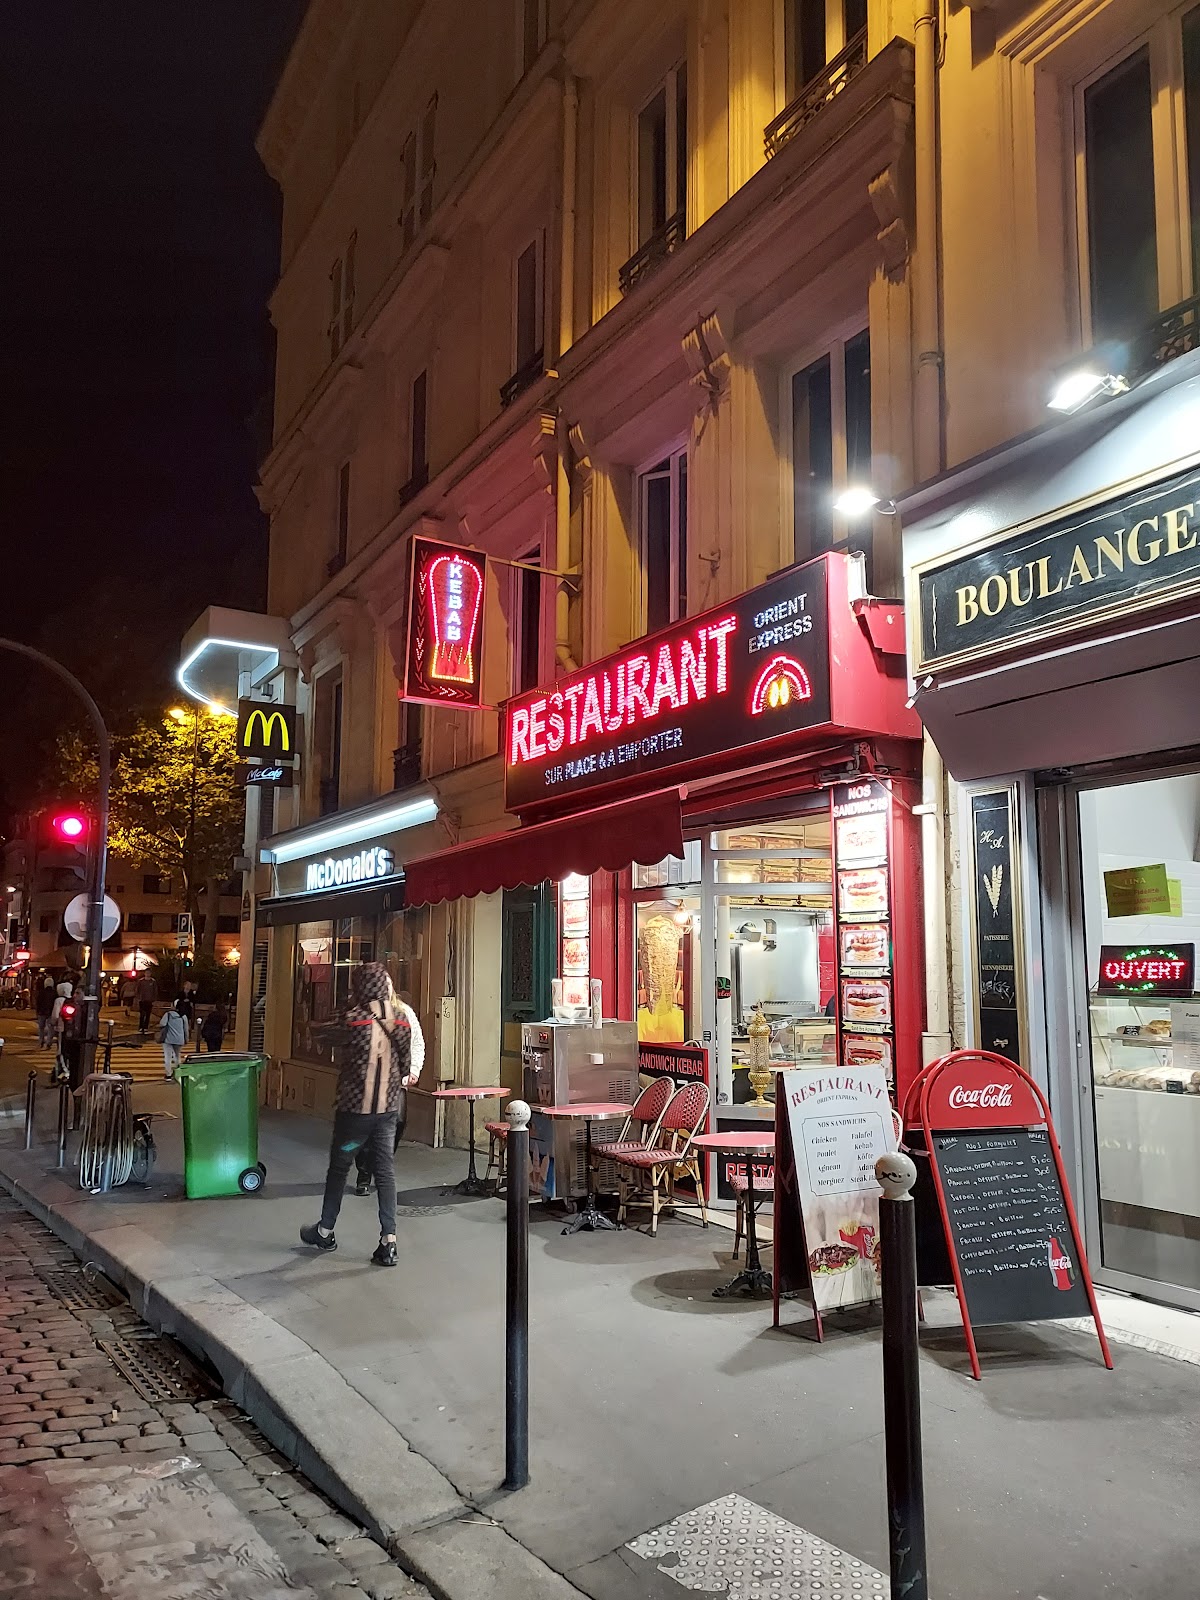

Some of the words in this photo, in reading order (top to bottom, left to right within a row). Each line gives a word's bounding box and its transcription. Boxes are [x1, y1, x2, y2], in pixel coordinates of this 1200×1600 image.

[955, 502, 1200, 627] BOULANGE
[446, 563, 463, 641] KEBAB
[753, 593, 808, 629] ORIENT
[748, 614, 813, 655] EXPRESS
[510, 615, 738, 766] RESTAURANT
[544, 765, 563, 786] SUR
[564, 754, 597, 780] PLACE
[617, 727, 683, 764] EMPORTER
[848, 784, 872, 800] NOS
[306, 846, 391, 891] McDonald's
[181, 917, 187, 930] P
[1105, 961, 1185, 979] OUVERT
[676, 1056, 703, 1077] KEBAB
[791, 1076, 885, 1108] RESTAURANT
[949, 1083, 1013, 1109] Coca-Cola
[817, 1120, 830, 1128] NOS
[811, 1135, 838, 1145] Chicken
[851, 1130, 873, 1140] Falafel
[816, 1149, 837, 1158] Poulet
[854, 1141, 874, 1150] Kebab
[818, 1163, 841, 1173] Agneau
[817, 1176, 845, 1187] Merguez
[850, 1174, 868, 1183] Steak
